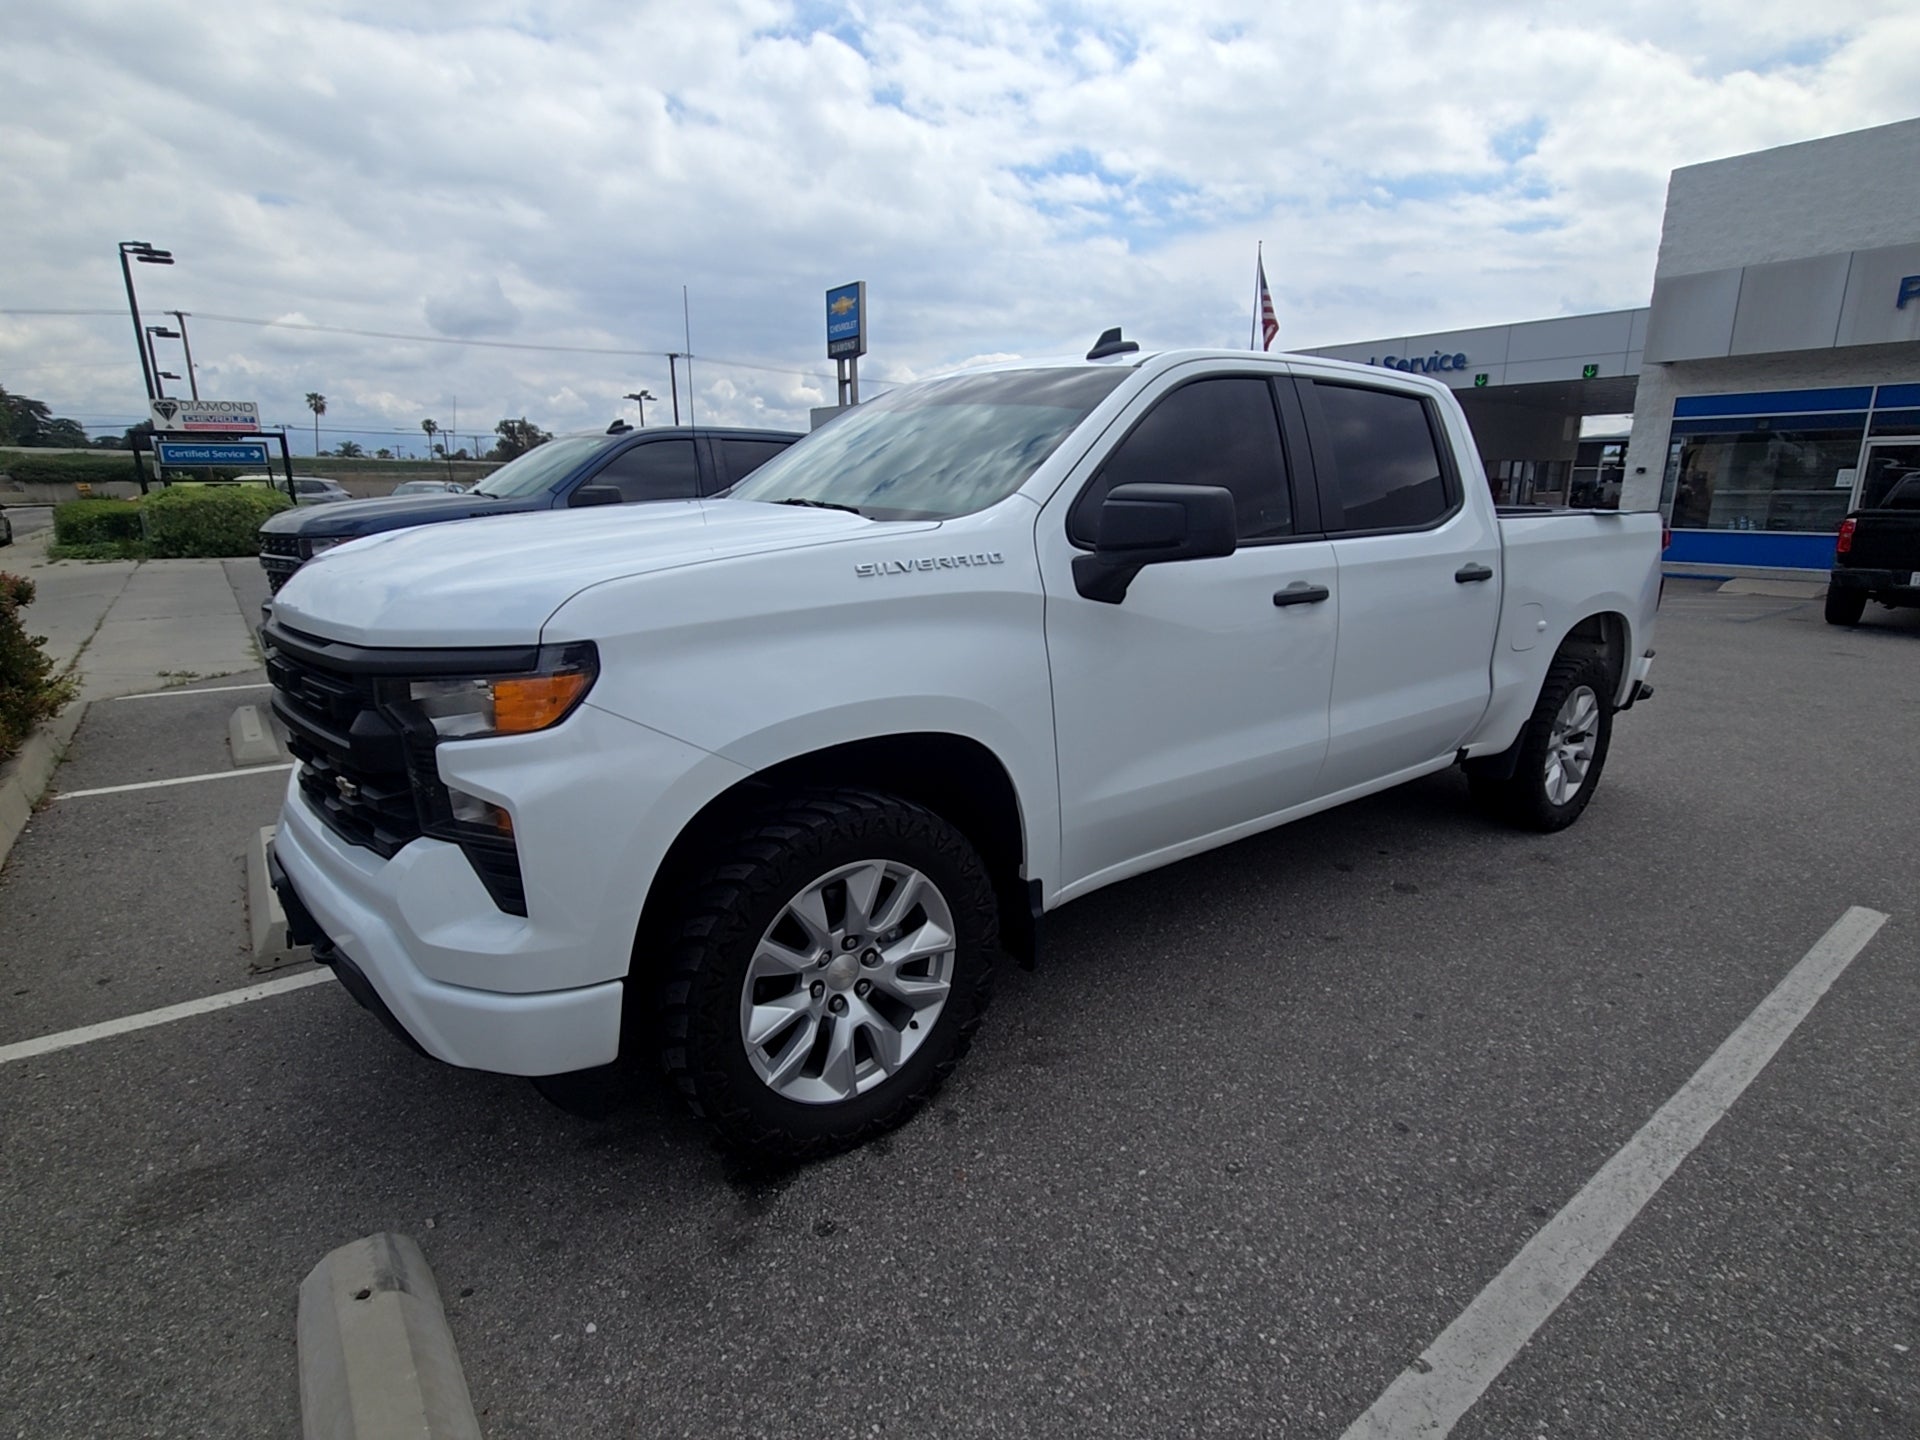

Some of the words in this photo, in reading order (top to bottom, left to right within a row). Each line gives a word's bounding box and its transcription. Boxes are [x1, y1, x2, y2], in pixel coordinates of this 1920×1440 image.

[829, 319, 858, 334] CHEVROLET
[1383, 350, 1467, 373] Service
[180, 400, 254, 412] DIAMOND
[184, 415, 252, 423] CHEVROLET
[168, 449, 210, 458] Certified
[212, 450, 245, 458] Service
[854, 551, 1005, 578] SILVERADO
